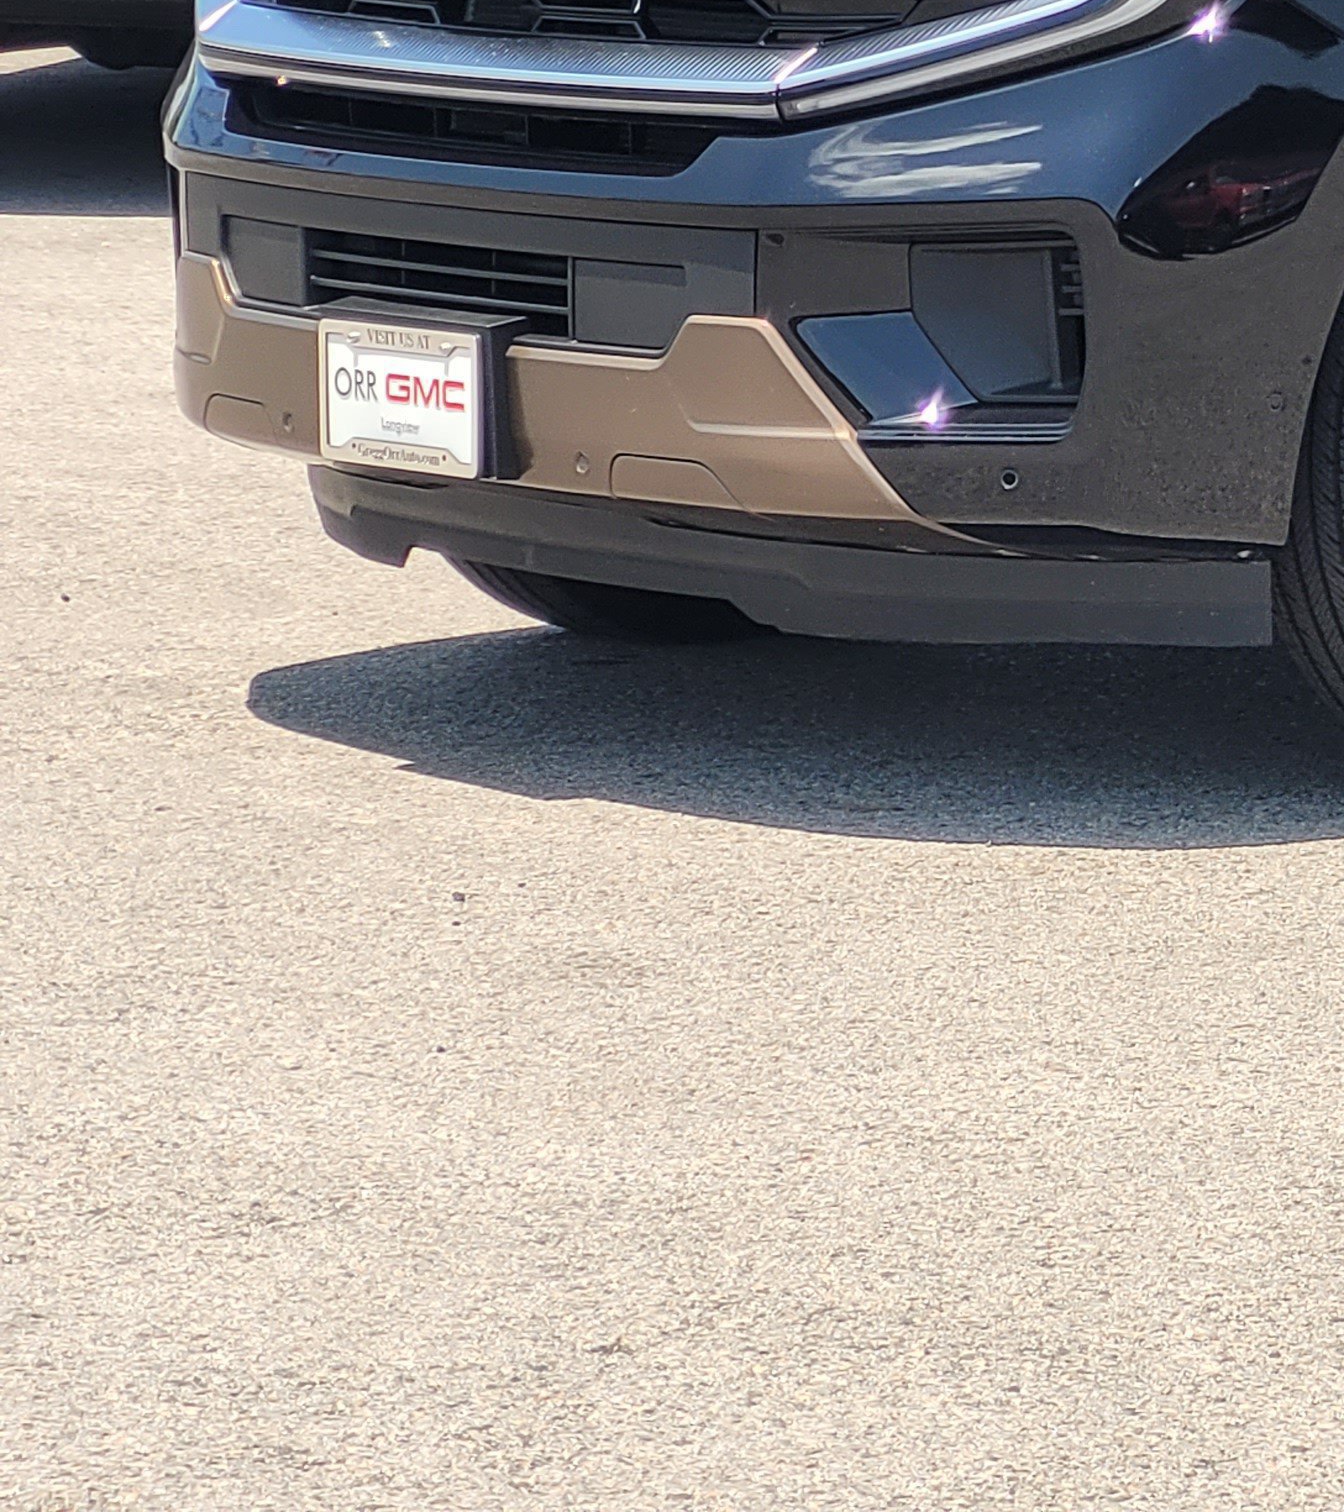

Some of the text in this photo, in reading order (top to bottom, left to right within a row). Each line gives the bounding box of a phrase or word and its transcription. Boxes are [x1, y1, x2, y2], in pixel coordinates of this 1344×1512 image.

[367, 328, 431, 350] VISIT US AT
[334, 366, 466, 412] ORR GMC
[381, 416, 420, 436] Longview
